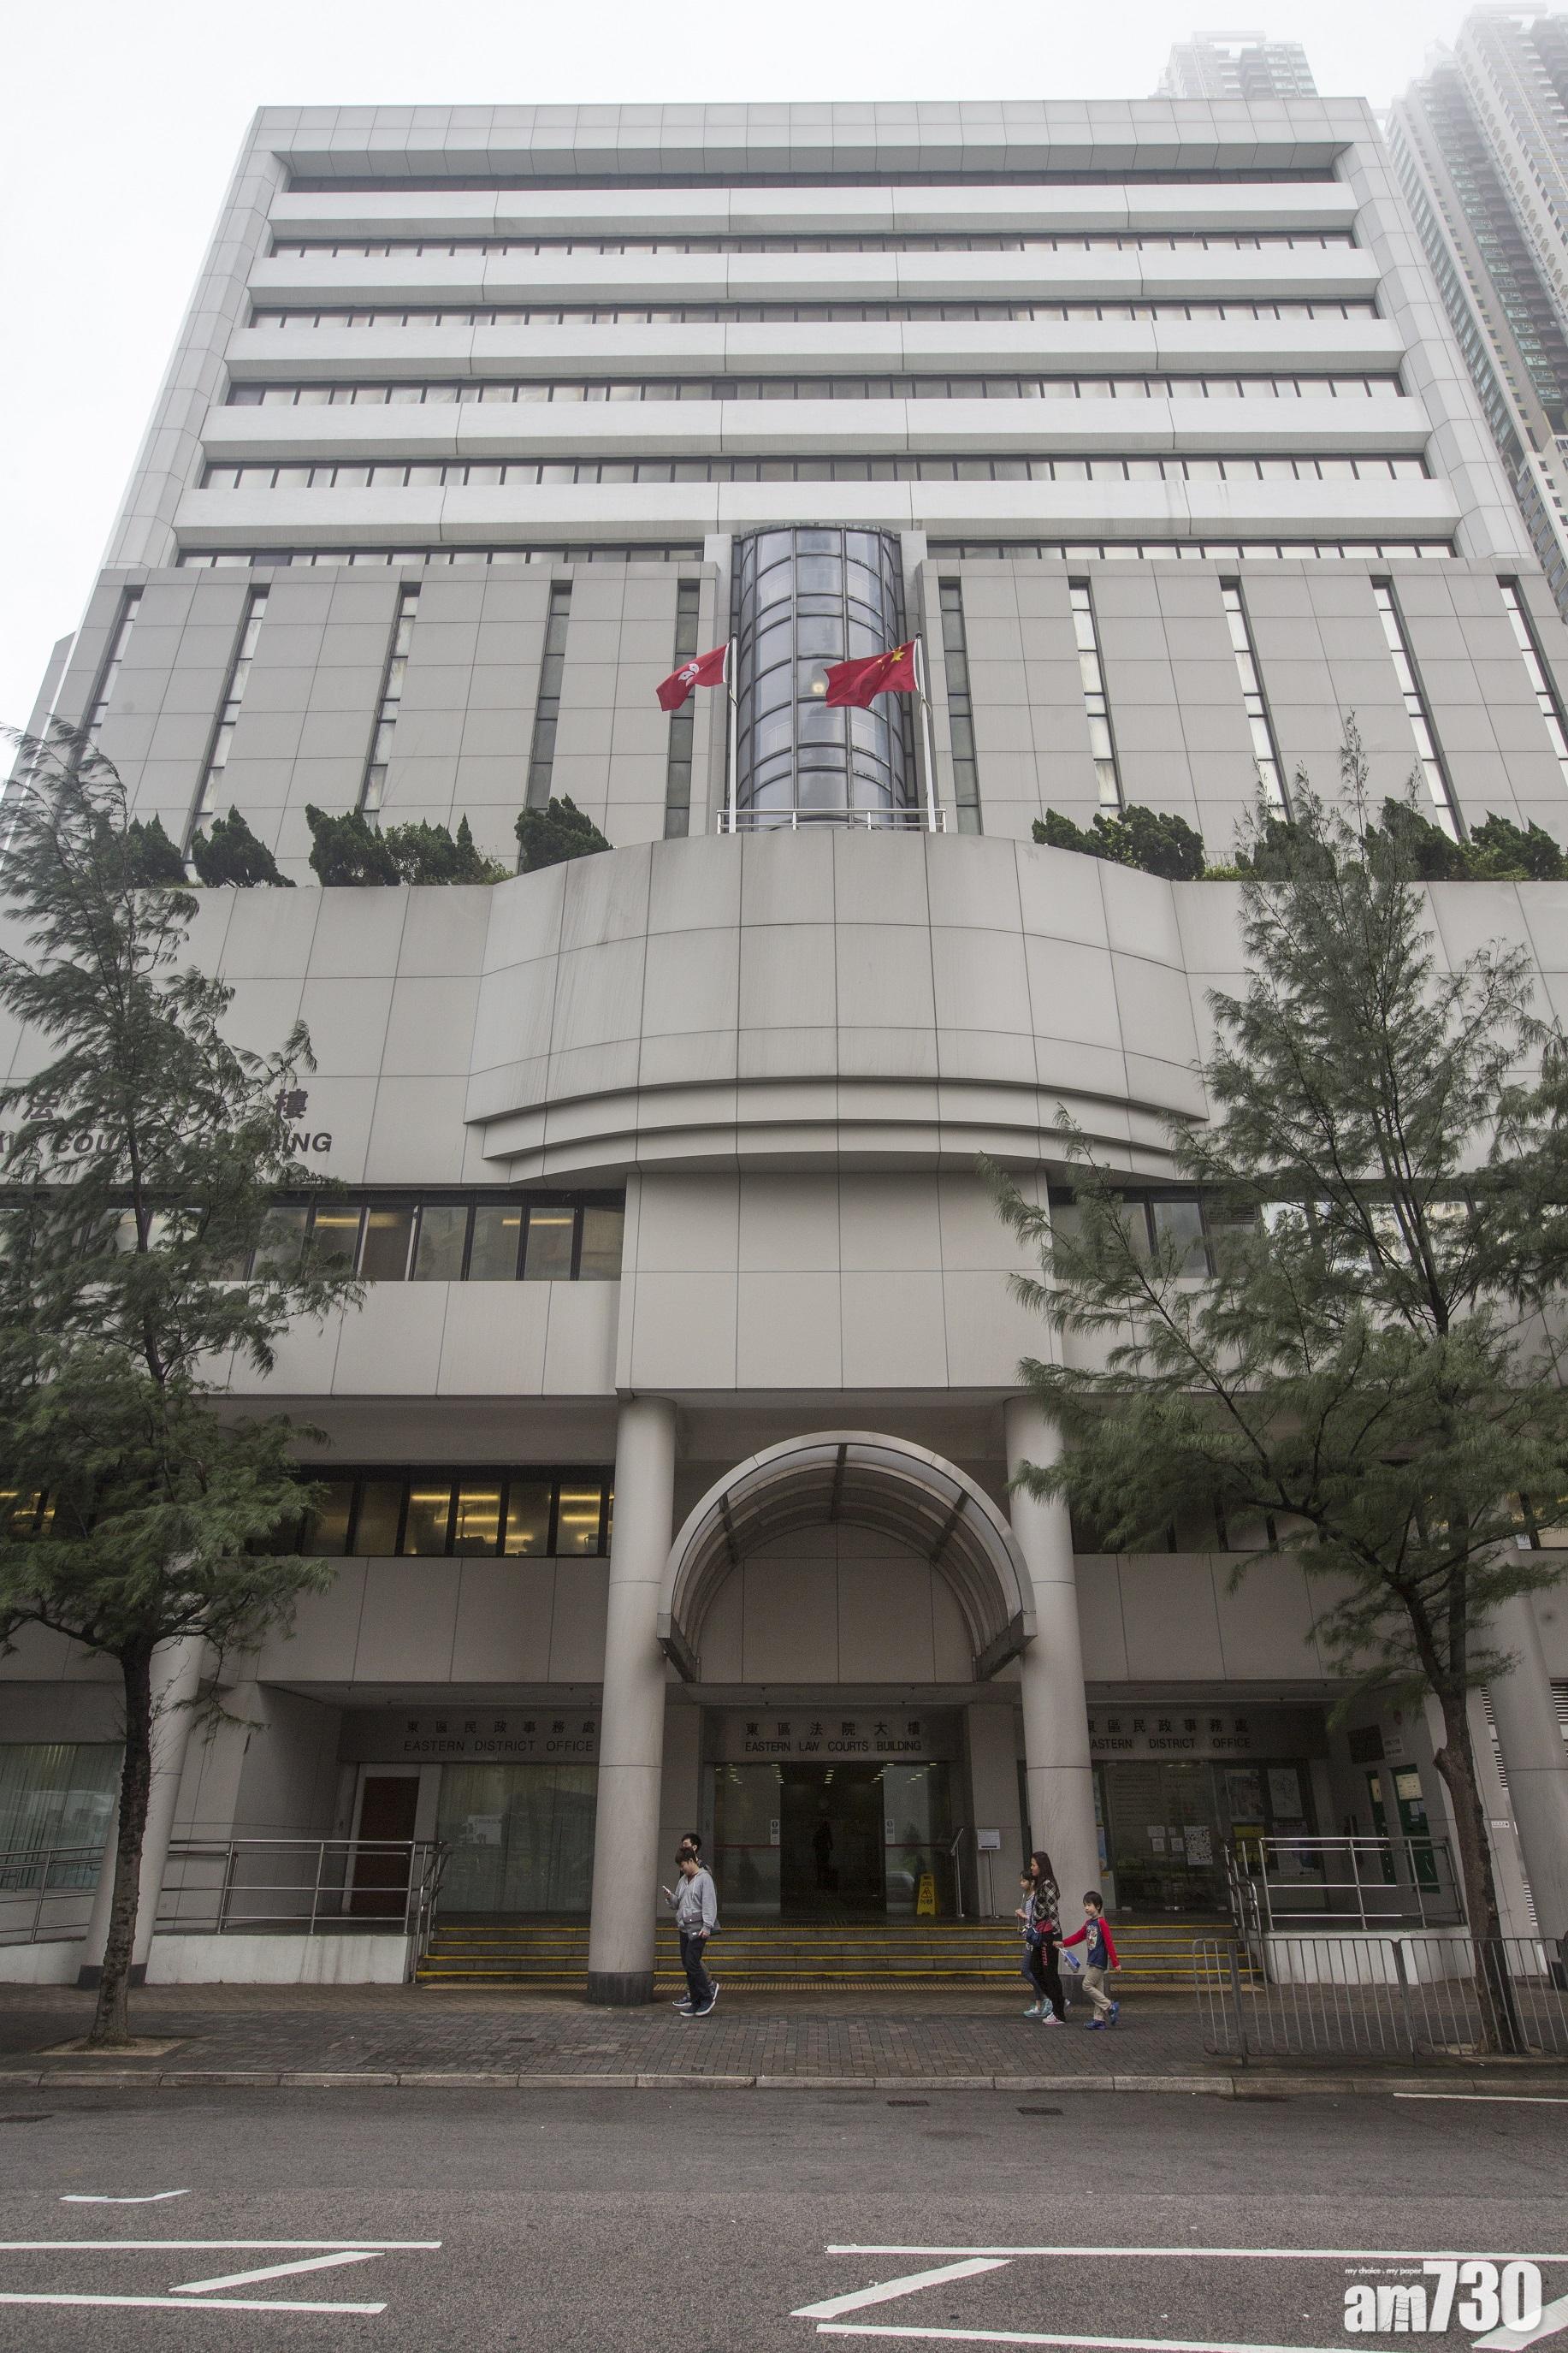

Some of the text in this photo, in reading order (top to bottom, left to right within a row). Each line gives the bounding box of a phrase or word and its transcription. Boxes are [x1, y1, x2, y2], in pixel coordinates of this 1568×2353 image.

[745, 1722, 920, 1736] 東區法院大樓
[403, 1740, 594, 1751] EASTERN DISTRICT OFFICE
[745, 1740, 921, 1751] EASTERN LAW COURTS BUILDING
[1090, 1737, 1251, 1749] ASTERN DISTRICT OFFICE
